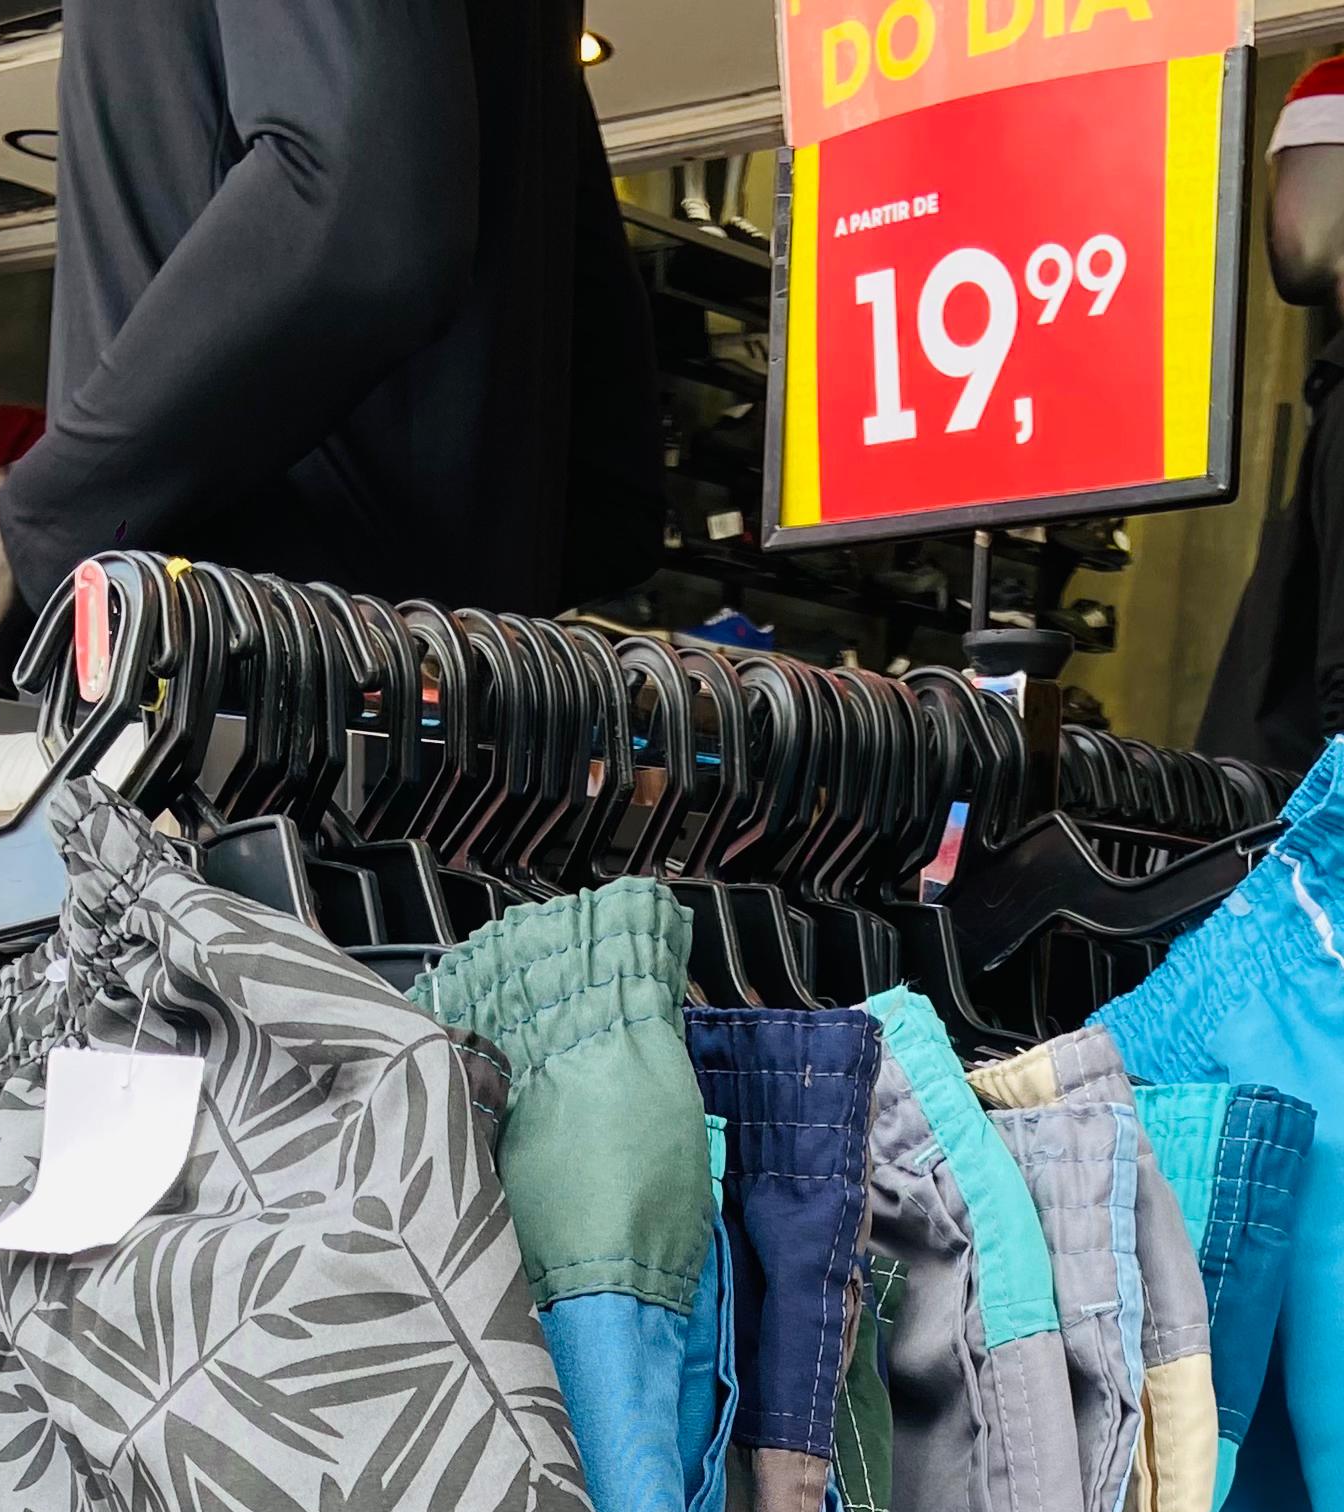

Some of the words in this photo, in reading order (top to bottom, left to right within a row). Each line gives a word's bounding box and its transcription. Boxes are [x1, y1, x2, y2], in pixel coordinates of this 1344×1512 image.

[822, 0, 936, 109] DO
[833, 216, 848, 238] A
[849, 200, 910, 234] PARTIR
[912, 192, 939, 217] DE
